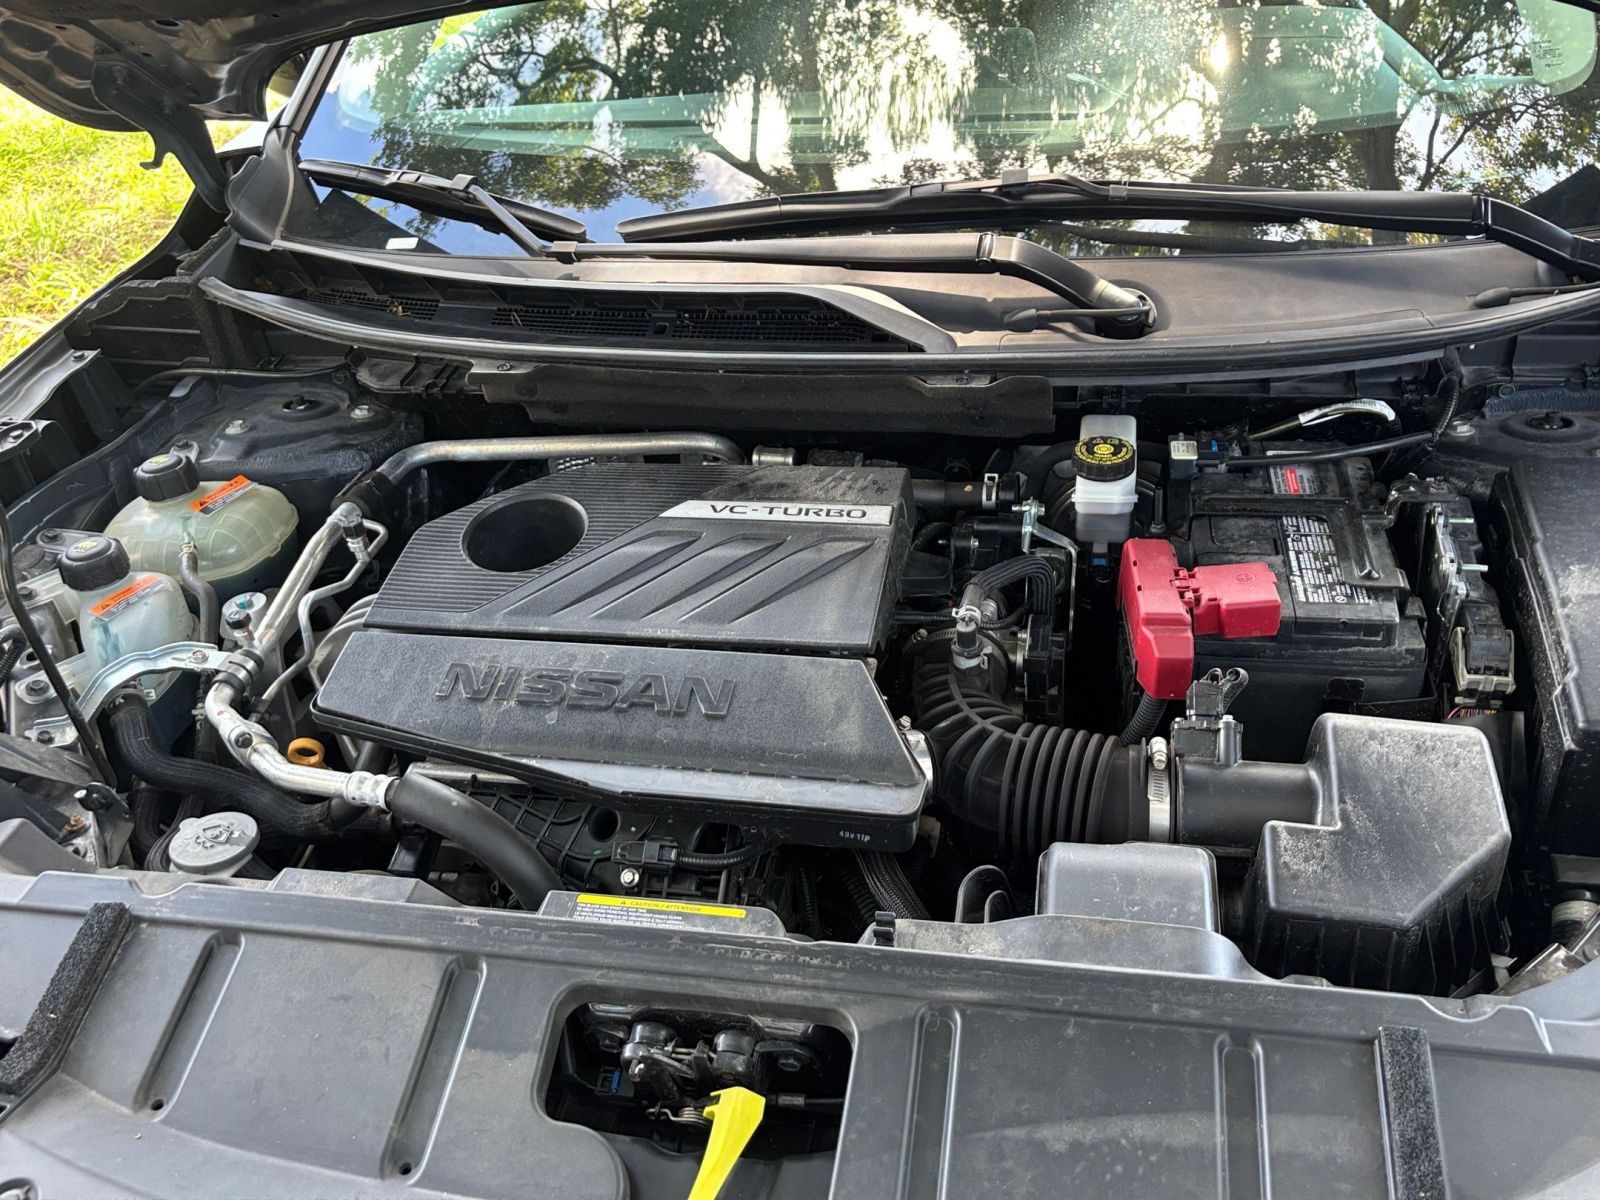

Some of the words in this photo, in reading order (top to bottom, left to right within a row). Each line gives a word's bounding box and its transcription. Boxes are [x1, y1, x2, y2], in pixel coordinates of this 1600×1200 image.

[710, 504, 867, 519] VC-TURBO
[435, 662, 736, 718] NISSAN
[630, 901, 660, 909] CAUTION
[665, 903, 701, 913] ATTENTION
